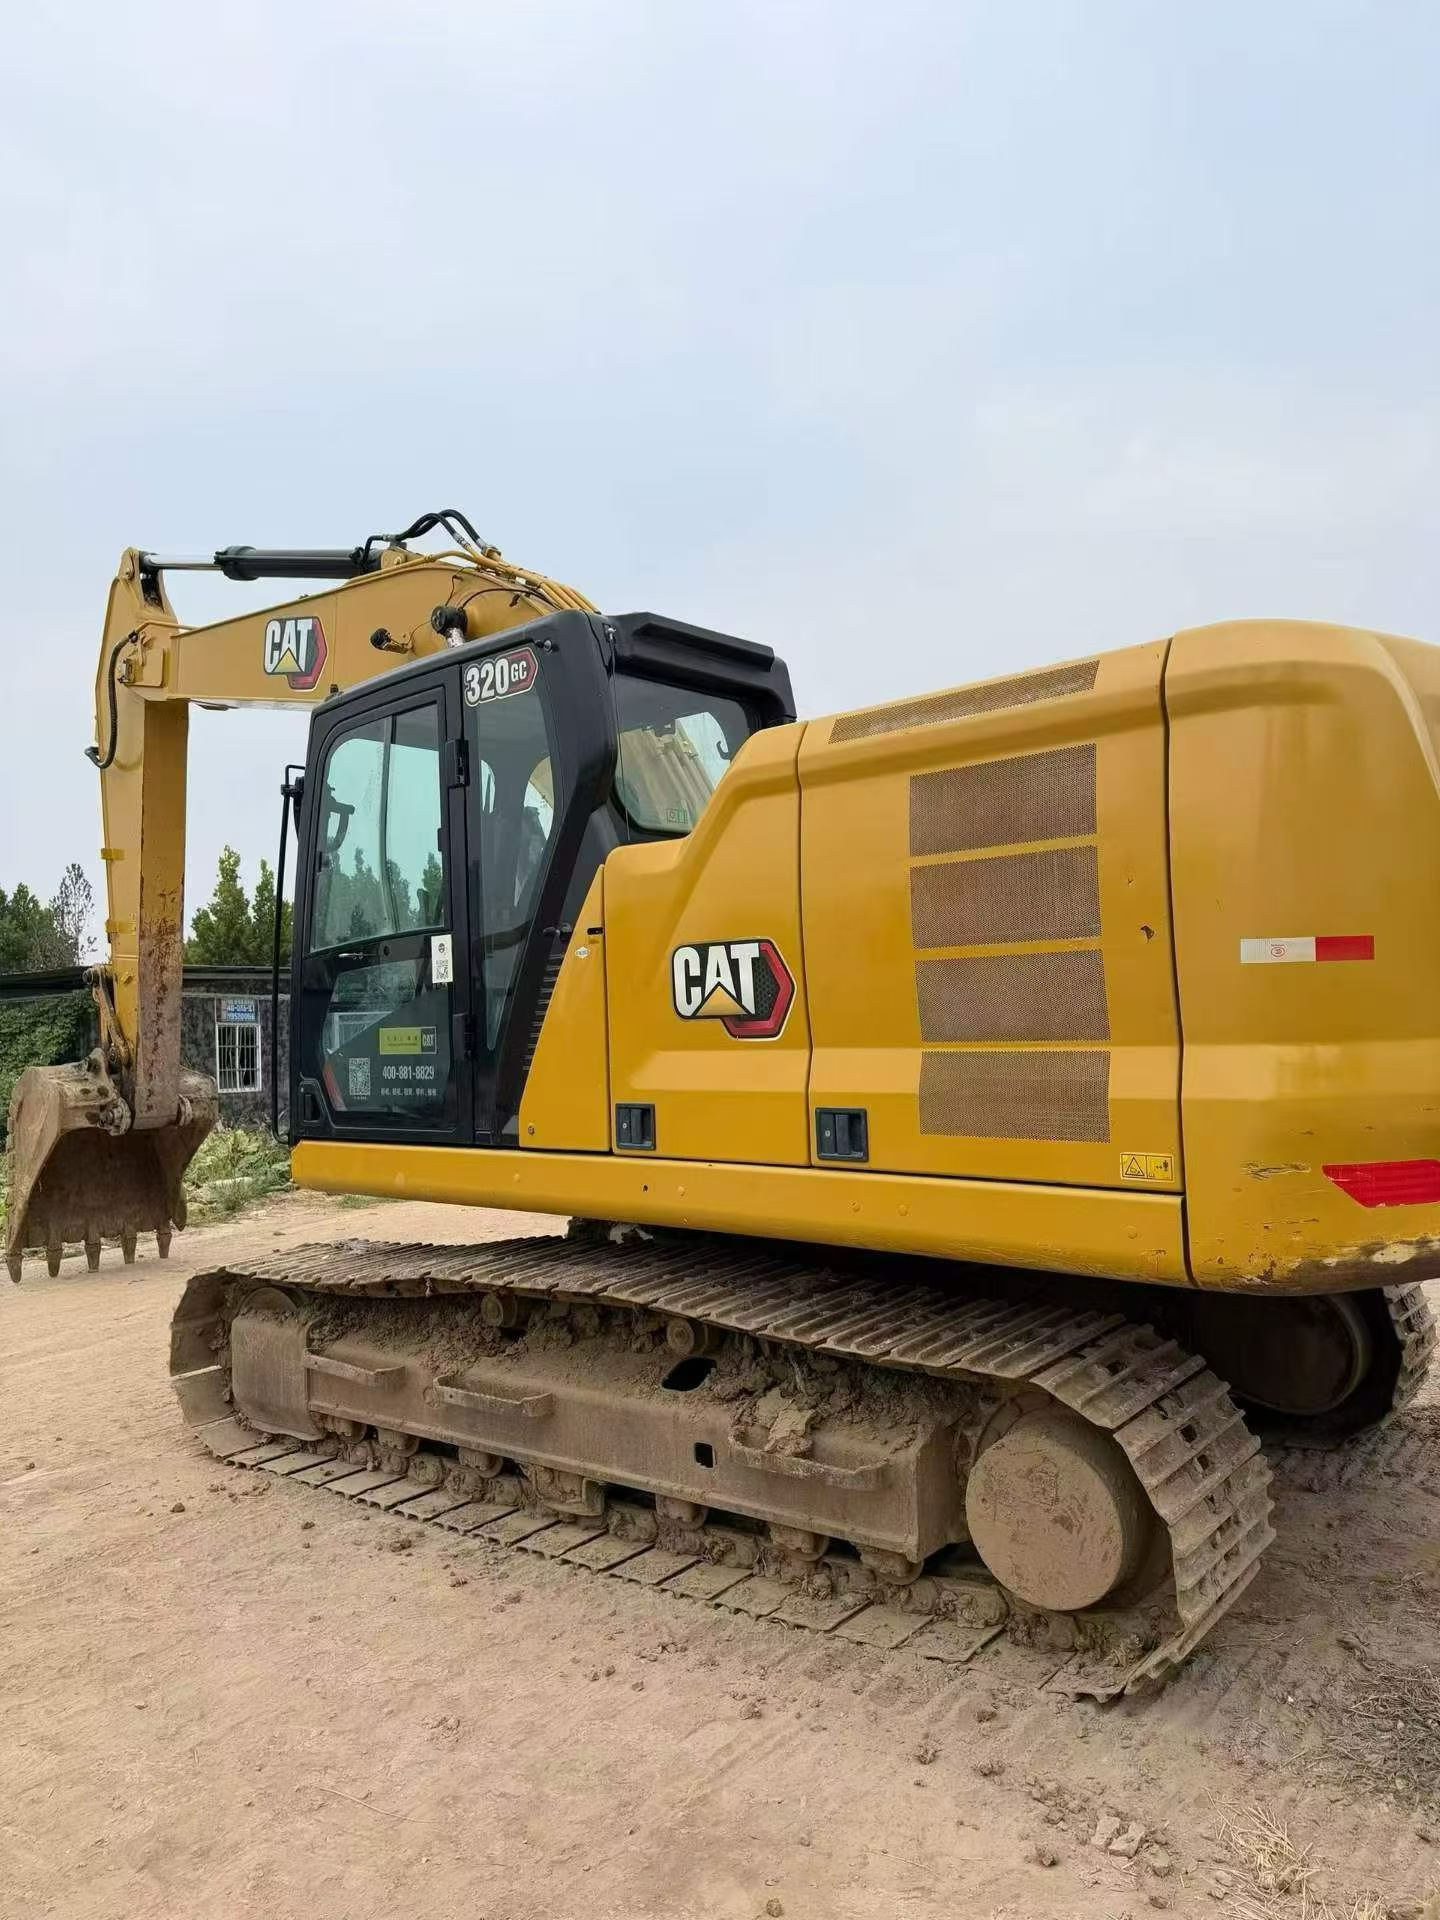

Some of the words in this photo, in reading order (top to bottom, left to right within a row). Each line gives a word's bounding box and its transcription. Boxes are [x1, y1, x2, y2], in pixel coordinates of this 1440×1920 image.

[265, 619, 313, 673] CAT
[466, 658, 509, 703] 320
[510, 661, 527, 682] GC
[673, 942, 760, 1017] CAT
[422, 1033, 434, 1047] CAT
[382, 1065, 435, 1080] 400-881-8829
